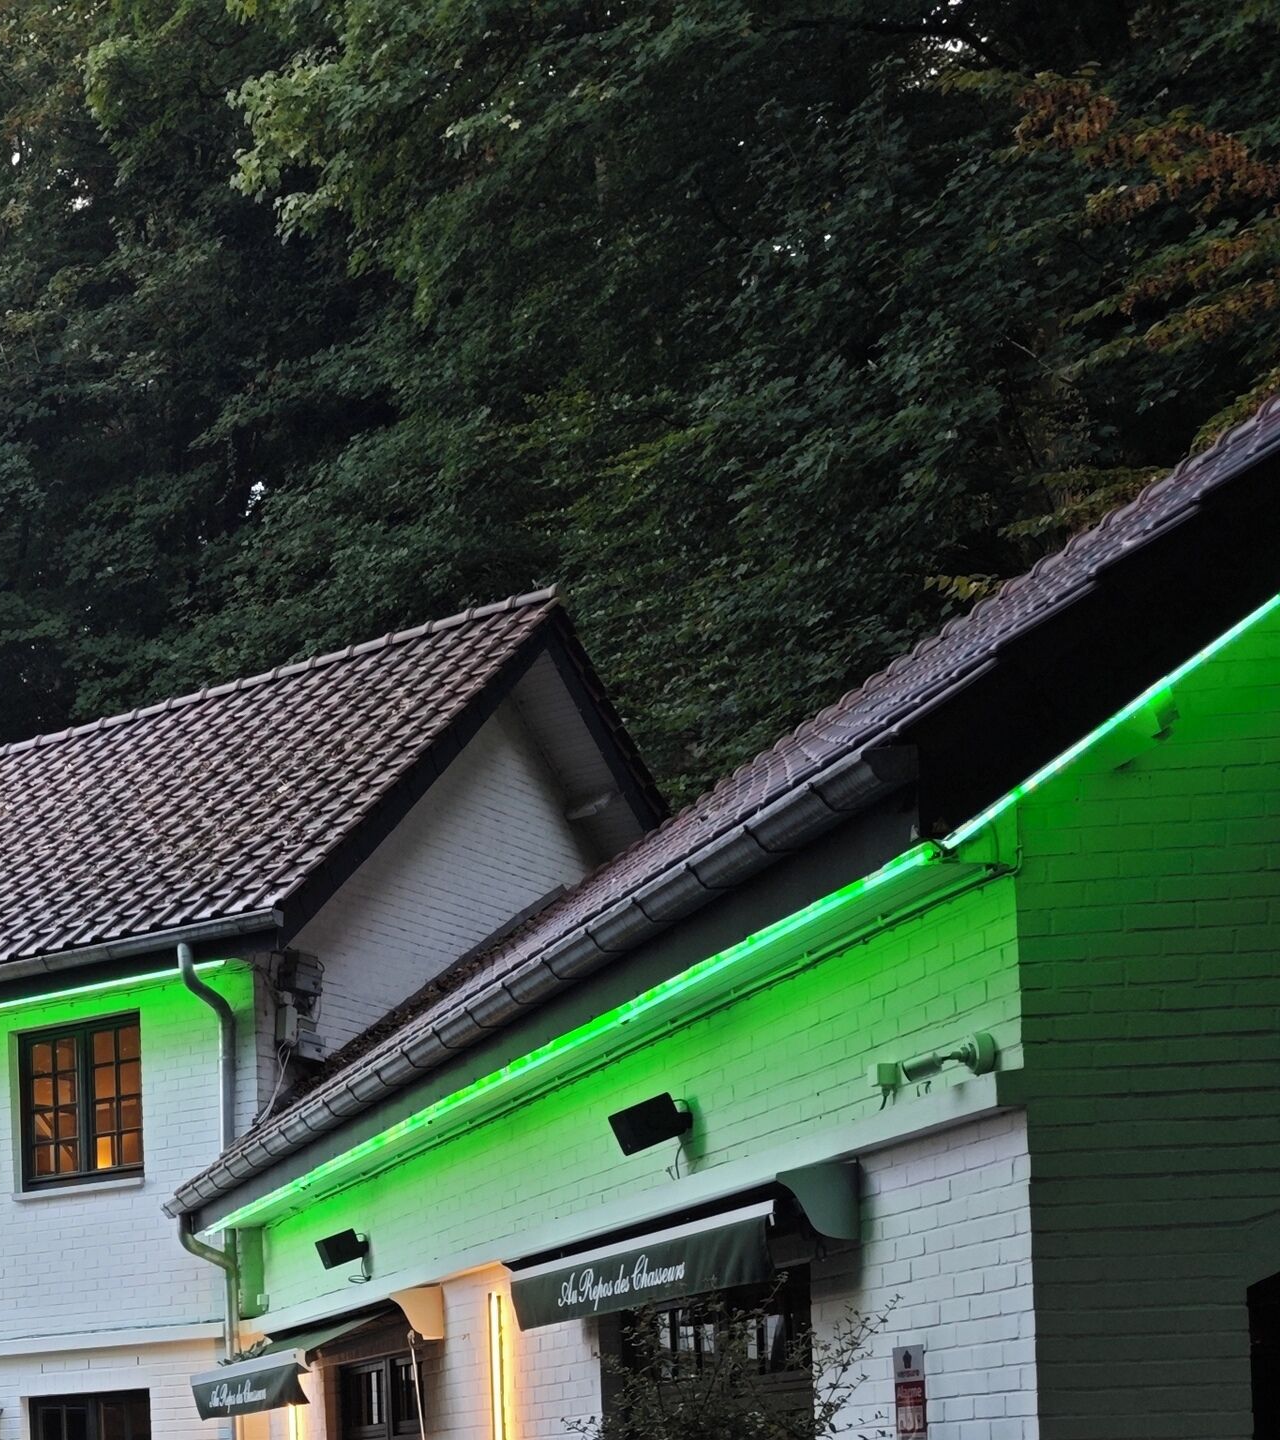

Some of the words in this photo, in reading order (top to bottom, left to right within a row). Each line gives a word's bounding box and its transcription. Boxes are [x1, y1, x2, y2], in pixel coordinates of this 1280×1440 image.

[558, 1272, 577, 1307] Au
[578, 1268, 613, 1311] Repos
[614, 1264, 630, 1294] des
[631, 1254, 686, 1290] Chasseurs
